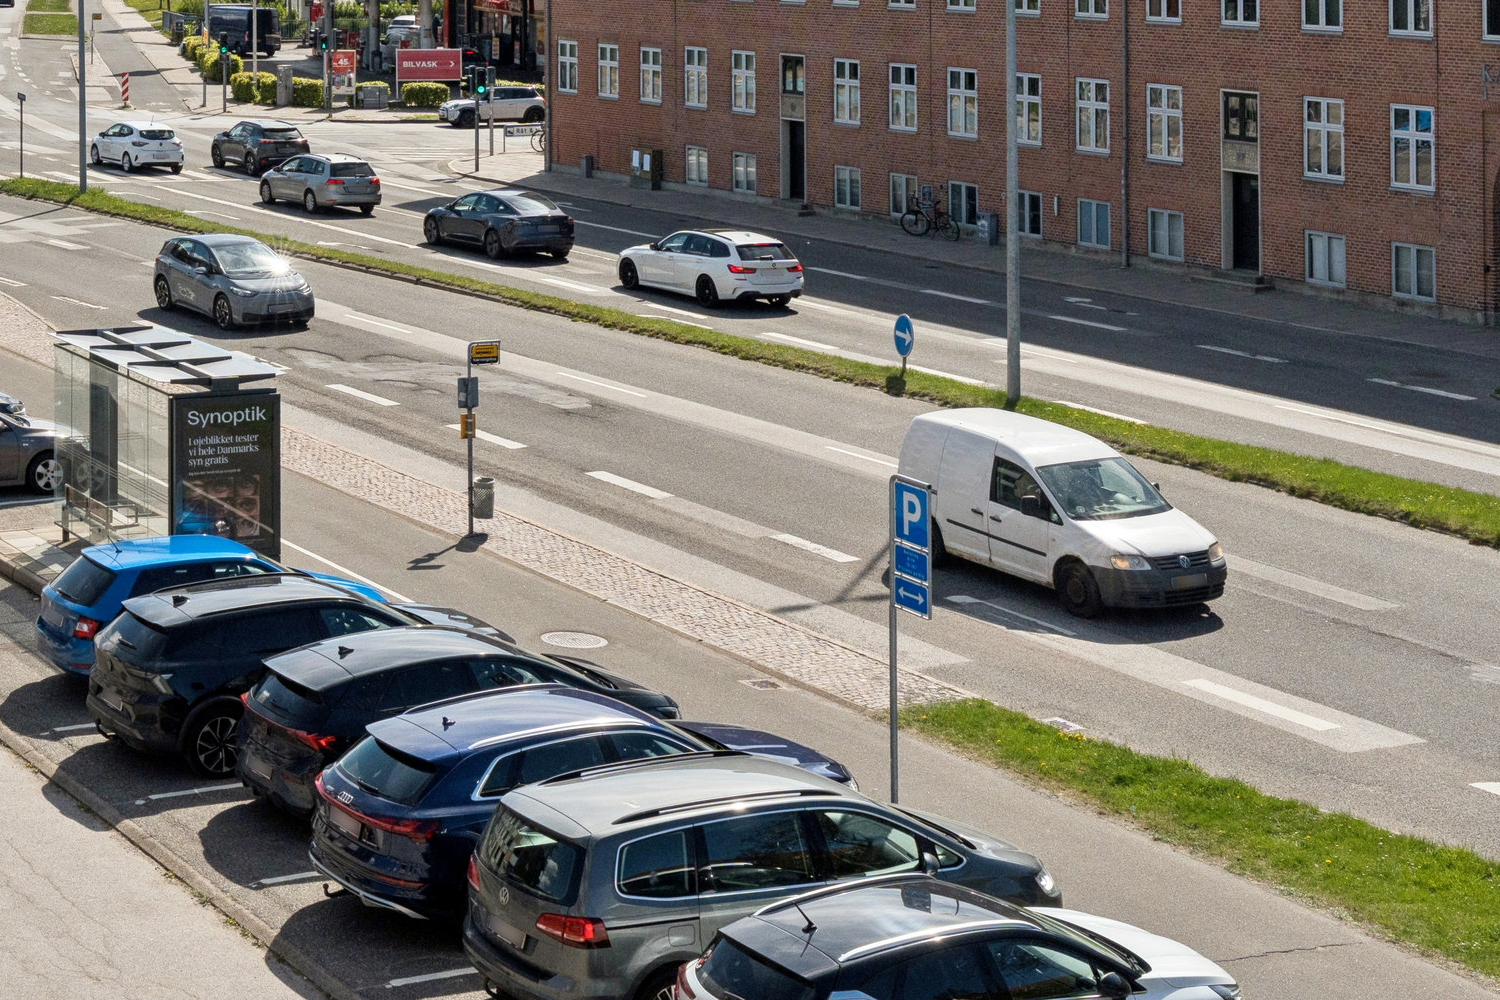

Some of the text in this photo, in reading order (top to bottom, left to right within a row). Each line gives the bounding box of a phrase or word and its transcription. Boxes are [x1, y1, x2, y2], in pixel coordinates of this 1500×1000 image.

[402, 60, 438, 68] BILVASK
[188, 406, 266, 428] Synoptik
[188, 434, 259, 447] I øjeblikket tester
[188, 443, 260, 456] vi hele Danmarks
[188, 455, 229, 468] syn gratis
[903, 491, 921, 536] P
